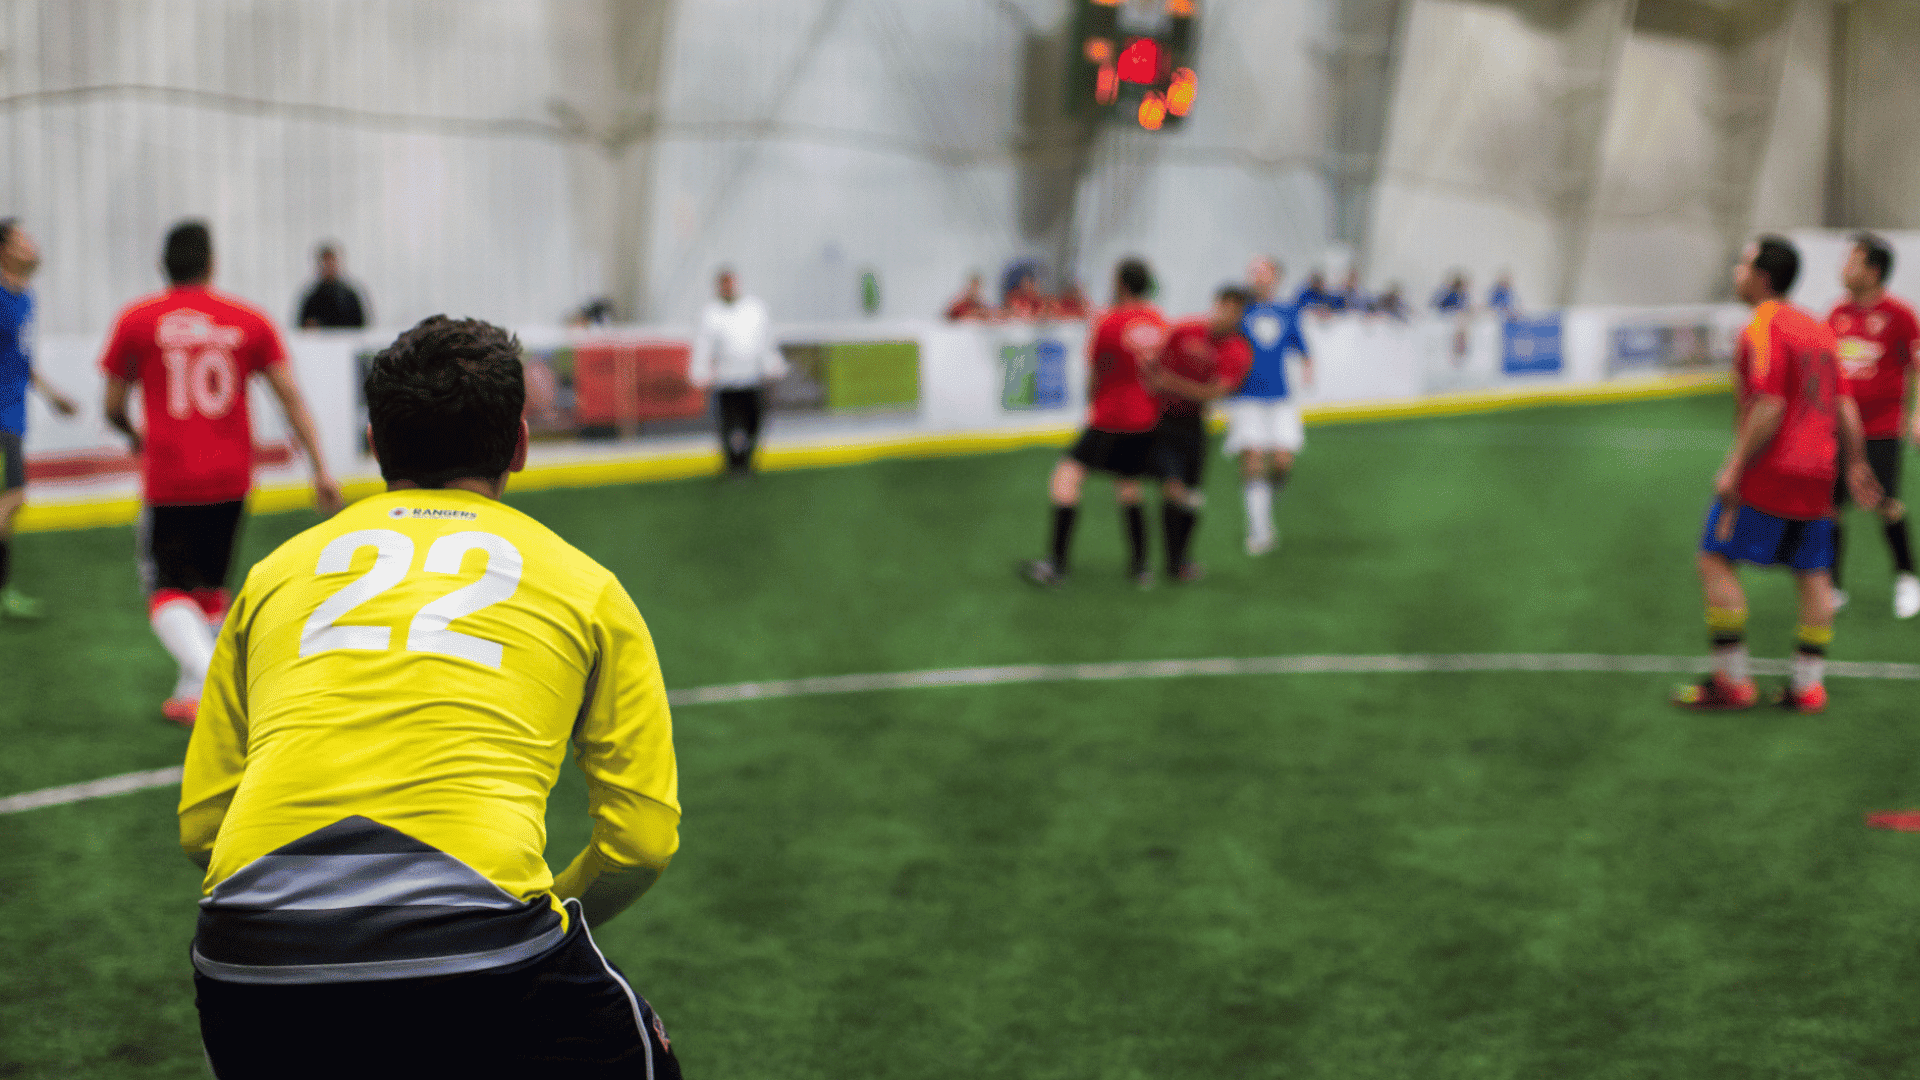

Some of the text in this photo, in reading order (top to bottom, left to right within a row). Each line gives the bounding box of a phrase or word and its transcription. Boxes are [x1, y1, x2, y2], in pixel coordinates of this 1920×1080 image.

[164, 349, 236, 418] 10
[412, 508, 477, 518] RANGERS
[298, 529, 524, 669] 22
